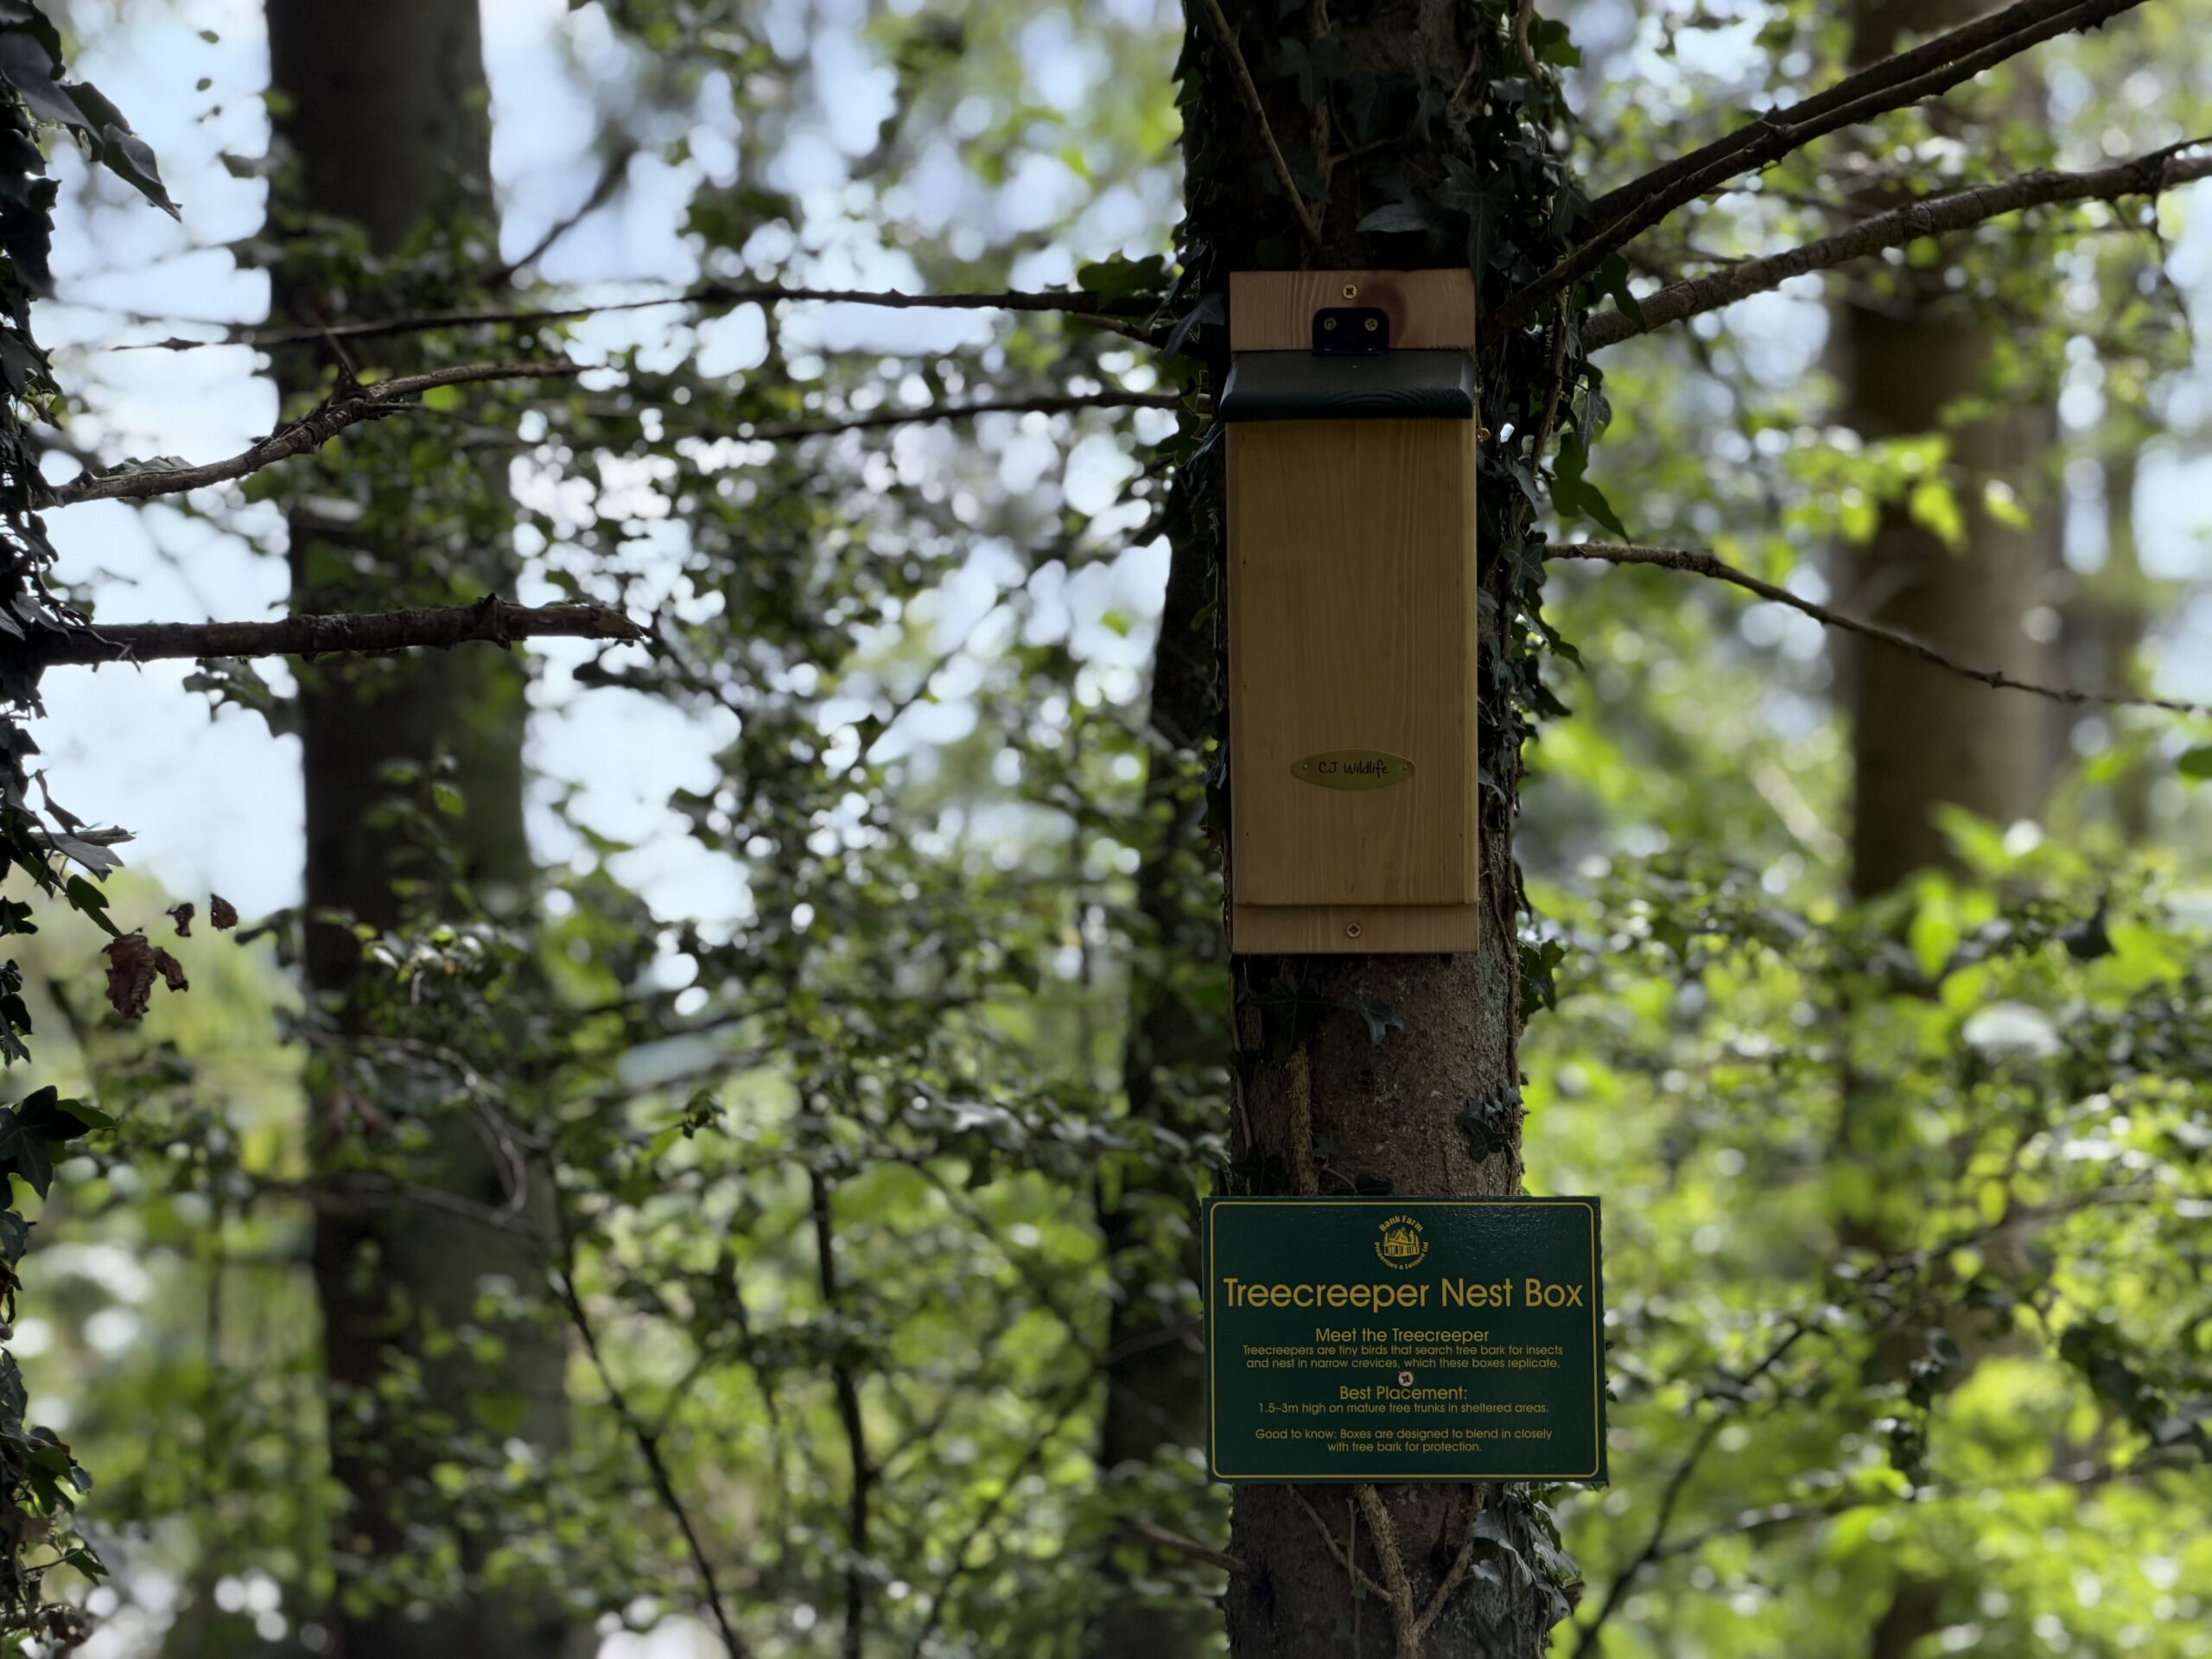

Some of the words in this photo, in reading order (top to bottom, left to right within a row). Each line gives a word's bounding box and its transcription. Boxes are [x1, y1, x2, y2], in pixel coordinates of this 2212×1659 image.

[1319, 761, 1338, 774] CJ
[1344, 760, 1390, 779] Wildlife
[1378, 1215, 1401, 1232] Bank
[1402, 1215, 1424, 1232] Farm
[1374, 1242, 1398, 1270] Properties
[1404, 1252, 1426, 1270] Leisure
[1224, 1278, 1429, 1313] Treecreeper
[1442, 1278, 1513, 1306] Nest
[1526, 1278, 1583, 1307] Box
[1316, 1328, 1357, 1342] Meet
[1362, 1328, 1387, 1342] the
[1392, 1328, 1489, 1344] Treecreeper
[1243, 1345, 1313, 1356] Treecreepers
[1339, 1345, 1357, 1356] tiny
[1362, 1345, 1387, 1355] birds
[1391, 1345, 1411, 1354] that
[1415, 1345, 1452, 1355] search
[1456, 1345, 1477, 1355] tree
[1481, 1345, 1505, 1354] bark
[1509, 1345, 1522, 1355] for
[1527, 1345, 1562, 1355] insects
[1247, 1358, 1268, 1368] and
[1273, 1358, 1294, 1368] nest
[1298, 1358, 1306, 1368] in
[1351, 1358, 1400, 1370] crevices,
[1404, 1358, 1436, 1368] which
[1440, 1358, 1469, 1367] these
[1472, 1358, 1504, 1368] boxes
[1508, 1358, 1560, 1370] replicate.
[1340, 1386, 1370, 1400] Best
[1377, 1386, 1466, 1400] Placement:
[1302, 1403, 1325, 1414] high
[1347, 1403, 1386, 1412] mature
[1389, 1403, 1410, 1413] tree
[1414, 1403, 1445, 1413] trunks
[1448, 1403, 1458, 1412] in
[1461, 1403, 1511, 1413] sheltered
[1255, 1429, 1287, 1439] Good
[1291, 1429, 1301, 1439] to
[1306, 1429, 1336, 1439] know:
[1341, 1429, 1371, 1439] Boxes
[1397, 1429, 1448, 1440] designed
[1452, 1429, 1463, 1438] to
[1466, 1428, 1498, 1438] blend
[1502, 1429, 1510, 1438] in
[1515, 1428, 1552, 1440] closely
[1328, 1442, 1349, 1452] with
[1352, 1442, 1373, 1452] tree
[1377, 1442, 1402, 1452] bark
[1406, 1442, 1419, 1451] for
[1423, 1442, 1481, 1453] protection.
